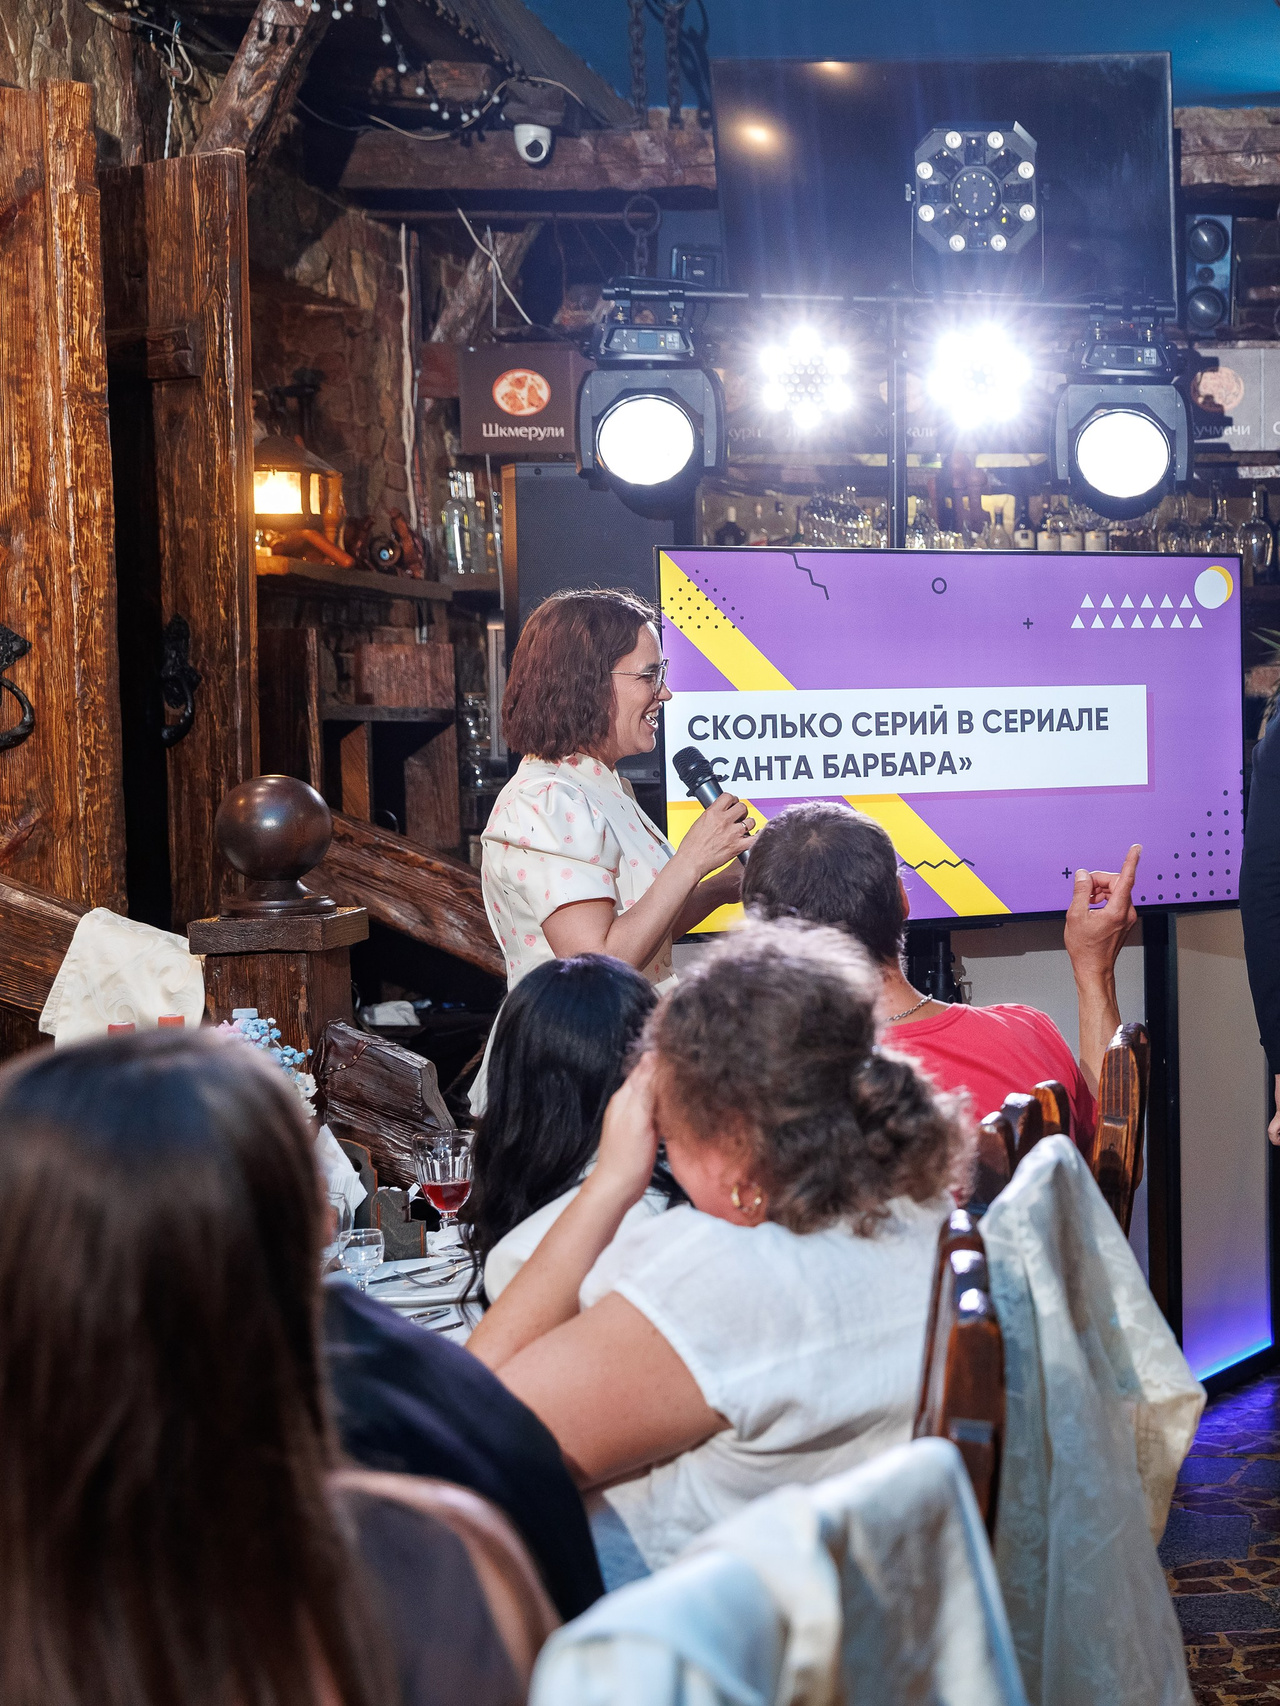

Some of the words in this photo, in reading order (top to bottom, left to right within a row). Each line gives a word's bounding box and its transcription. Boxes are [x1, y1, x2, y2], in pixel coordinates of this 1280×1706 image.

[482, 423, 565, 441] Шкмерули
[687, 712, 843, 741] СКОЛЬКО
[851, 704, 949, 737] СЕРИЙ
[957, 709, 975, 734] В
[982, 707, 1110, 735] СЕРИАЛЕ
[710, 754, 814, 782] САНТА
[823, 750, 973, 779] БАРБАРА»
